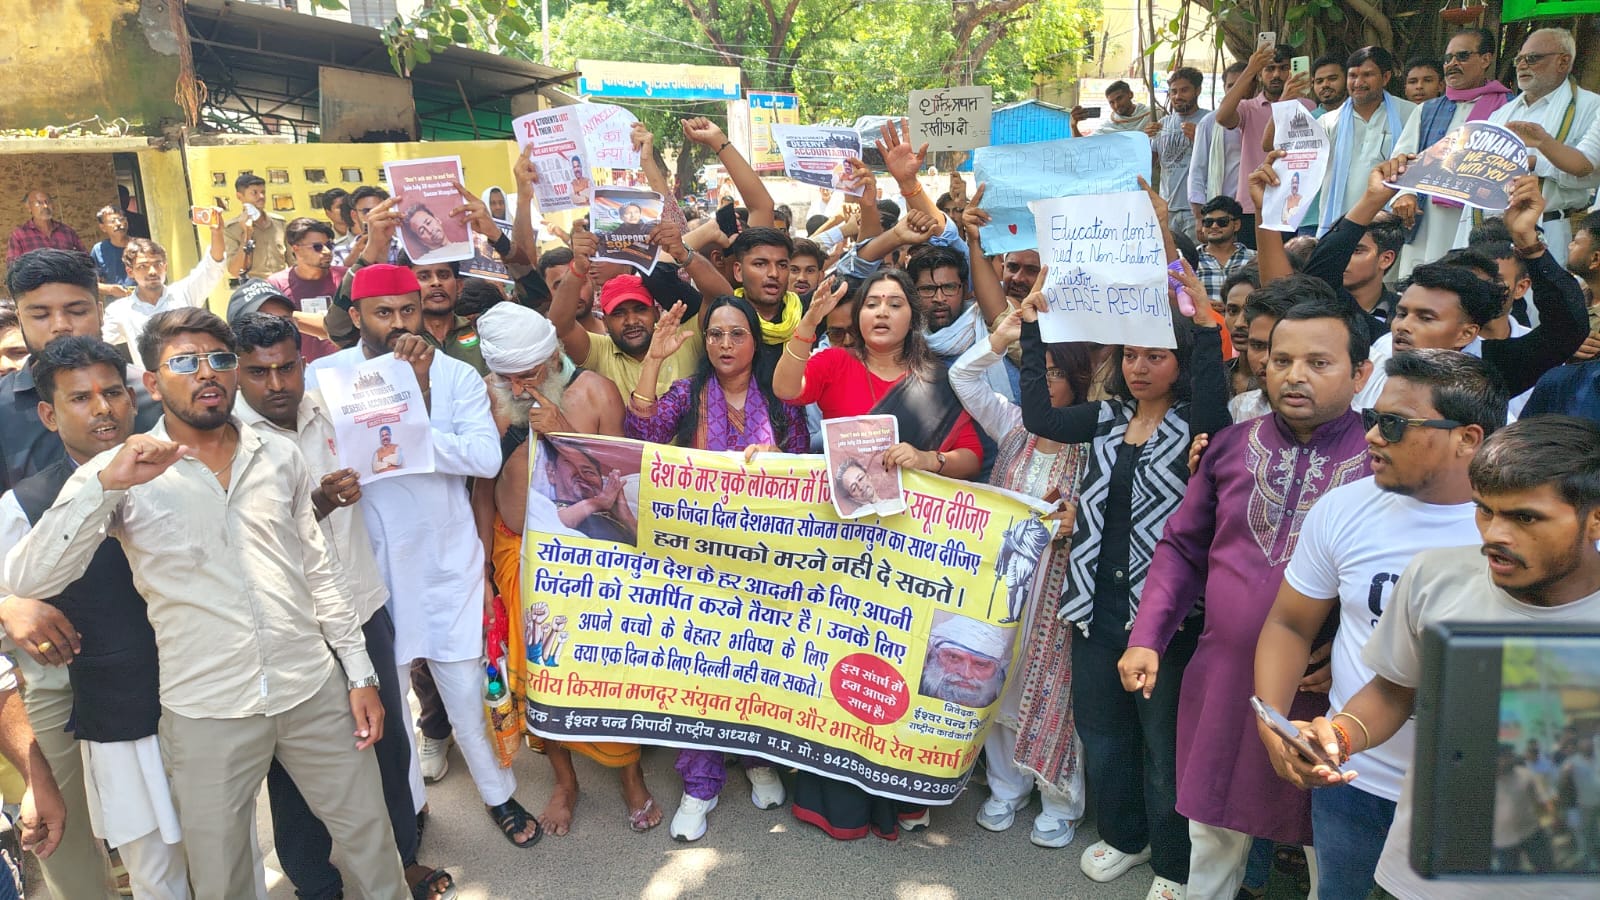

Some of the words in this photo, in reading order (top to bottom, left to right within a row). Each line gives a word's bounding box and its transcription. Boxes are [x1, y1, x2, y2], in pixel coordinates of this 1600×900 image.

[524, 120, 539, 138] 21
[956, 117, 969, 135] दो
[1464, 130, 1518, 158] SONAM
[1456, 162, 1486, 175] WITH
[1483, 168, 1510, 182] YOU
[1463, 151, 1486, 162] WE
[1483, 155, 1518, 172] STAND
[1052, 215, 1118, 240] Education
[1122, 212, 1156, 242] don't
[1076, 250, 1084, 264] a
[242, 282, 274, 294] ROYAL
[1048, 286, 1102, 314] PLEASE
[651, 452, 674, 488] देश
[678, 456, 694, 489] के
[695, 467, 718, 492] मर
[720, 465, 748, 504] चुके
[748, 468, 800, 501] लोकतंत्र
[802, 470, 817, 502] में
[910, 493, 946, 534] सबूत
[946, 491, 990, 540] दीजिए
[652, 502, 674, 519] एक
[678, 498, 708, 526] जिंदा
[712, 503, 736, 528] दिल
[740, 506, 794, 535] देशभक्त
[796, 513, 840, 539] सोनम
[888, 527, 907, 552] का
[908, 536, 938, 562] साथ
[939, 538, 982, 575] दीजिए
[654, 530, 690, 550] हम
[695, 540, 770, 563] आपको
[774, 548, 827, 572] मरने
[832, 552, 873, 580] नही
[877, 558, 892, 588] दे
[896, 570, 954, 604] सकते
[537, 538, 593, 566] सोनम
[596, 546, 660, 579] वांगचुंग
[664, 556, 693, 580] देश
[697, 564, 715, 584] के
[718, 572, 742, 590] हर
[744, 577, 804, 602] आदमी
[808, 583, 826, 604] के
[830, 584, 861, 617] लिए
[863, 601, 913, 632] अपनी
[534, 568, 594, 598] जिंदगी
[598, 577, 623, 600] को
[628, 583, 694, 611] समर्पित
[698, 596, 743, 620] करने
[748, 600, 792, 628] तैयार
[798, 608, 812, 633] है
[827, 621, 870, 648] उनके
[874, 630, 907, 664] लिए
[578, 608, 612, 632] अपने
[620, 613, 652, 636] बच्चो
[661, 616, 676, 638] के
[684, 620, 721, 646] बेहतर
[728, 628, 774, 656] भविष्य
[782, 637, 796, 660] के
[804, 640, 829, 671] लिए
[574, 644, 598, 662] क्या
[602, 647, 623, 666] एक
[624, 641, 650, 666] दिन
[651, 646, 666, 668] के
[667, 648, 692, 676] लिए
[694, 652, 731, 679] दिल्ली
[733, 660, 758, 684] नही
[760, 668, 780, 687] चल
[840, 662, 859, 676] इस
[862, 669, 889, 688] संघर्ष
[892, 680, 904, 692] में
[841, 678, 861, 693] हम
[863, 686, 898, 707] आपके
[848, 696, 872, 714] साथ
[526, 669, 564, 695] रतीय
[566, 672, 623, 698] किसान
[626, 682, 678, 710] मजदूर
[681, 686, 732, 716] संयुक्त
[735, 692, 794, 720] यूनियन
[796, 707, 828, 733] और
[829, 720, 888, 754] भारतीय
[890, 736, 916, 762] रेल
[917, 746, 962, 769] संघर्ष
[914, 707, 941, 724] ईश्वर
[944, 716, 966, 730] चन्द्र
[528, 706, 548, 722] दक
[564, 710, 598, 730] ईश्वर
[602, 716, 628, 730] चन्द्र
[631, 714, 672, 733] त्रिपाठी
[675, 721, 714, 740] राष्ट्रीय
[718, 728, 762, 744] अध्यक्ष
[823, 752, 961, 794] 9425885964,92380
